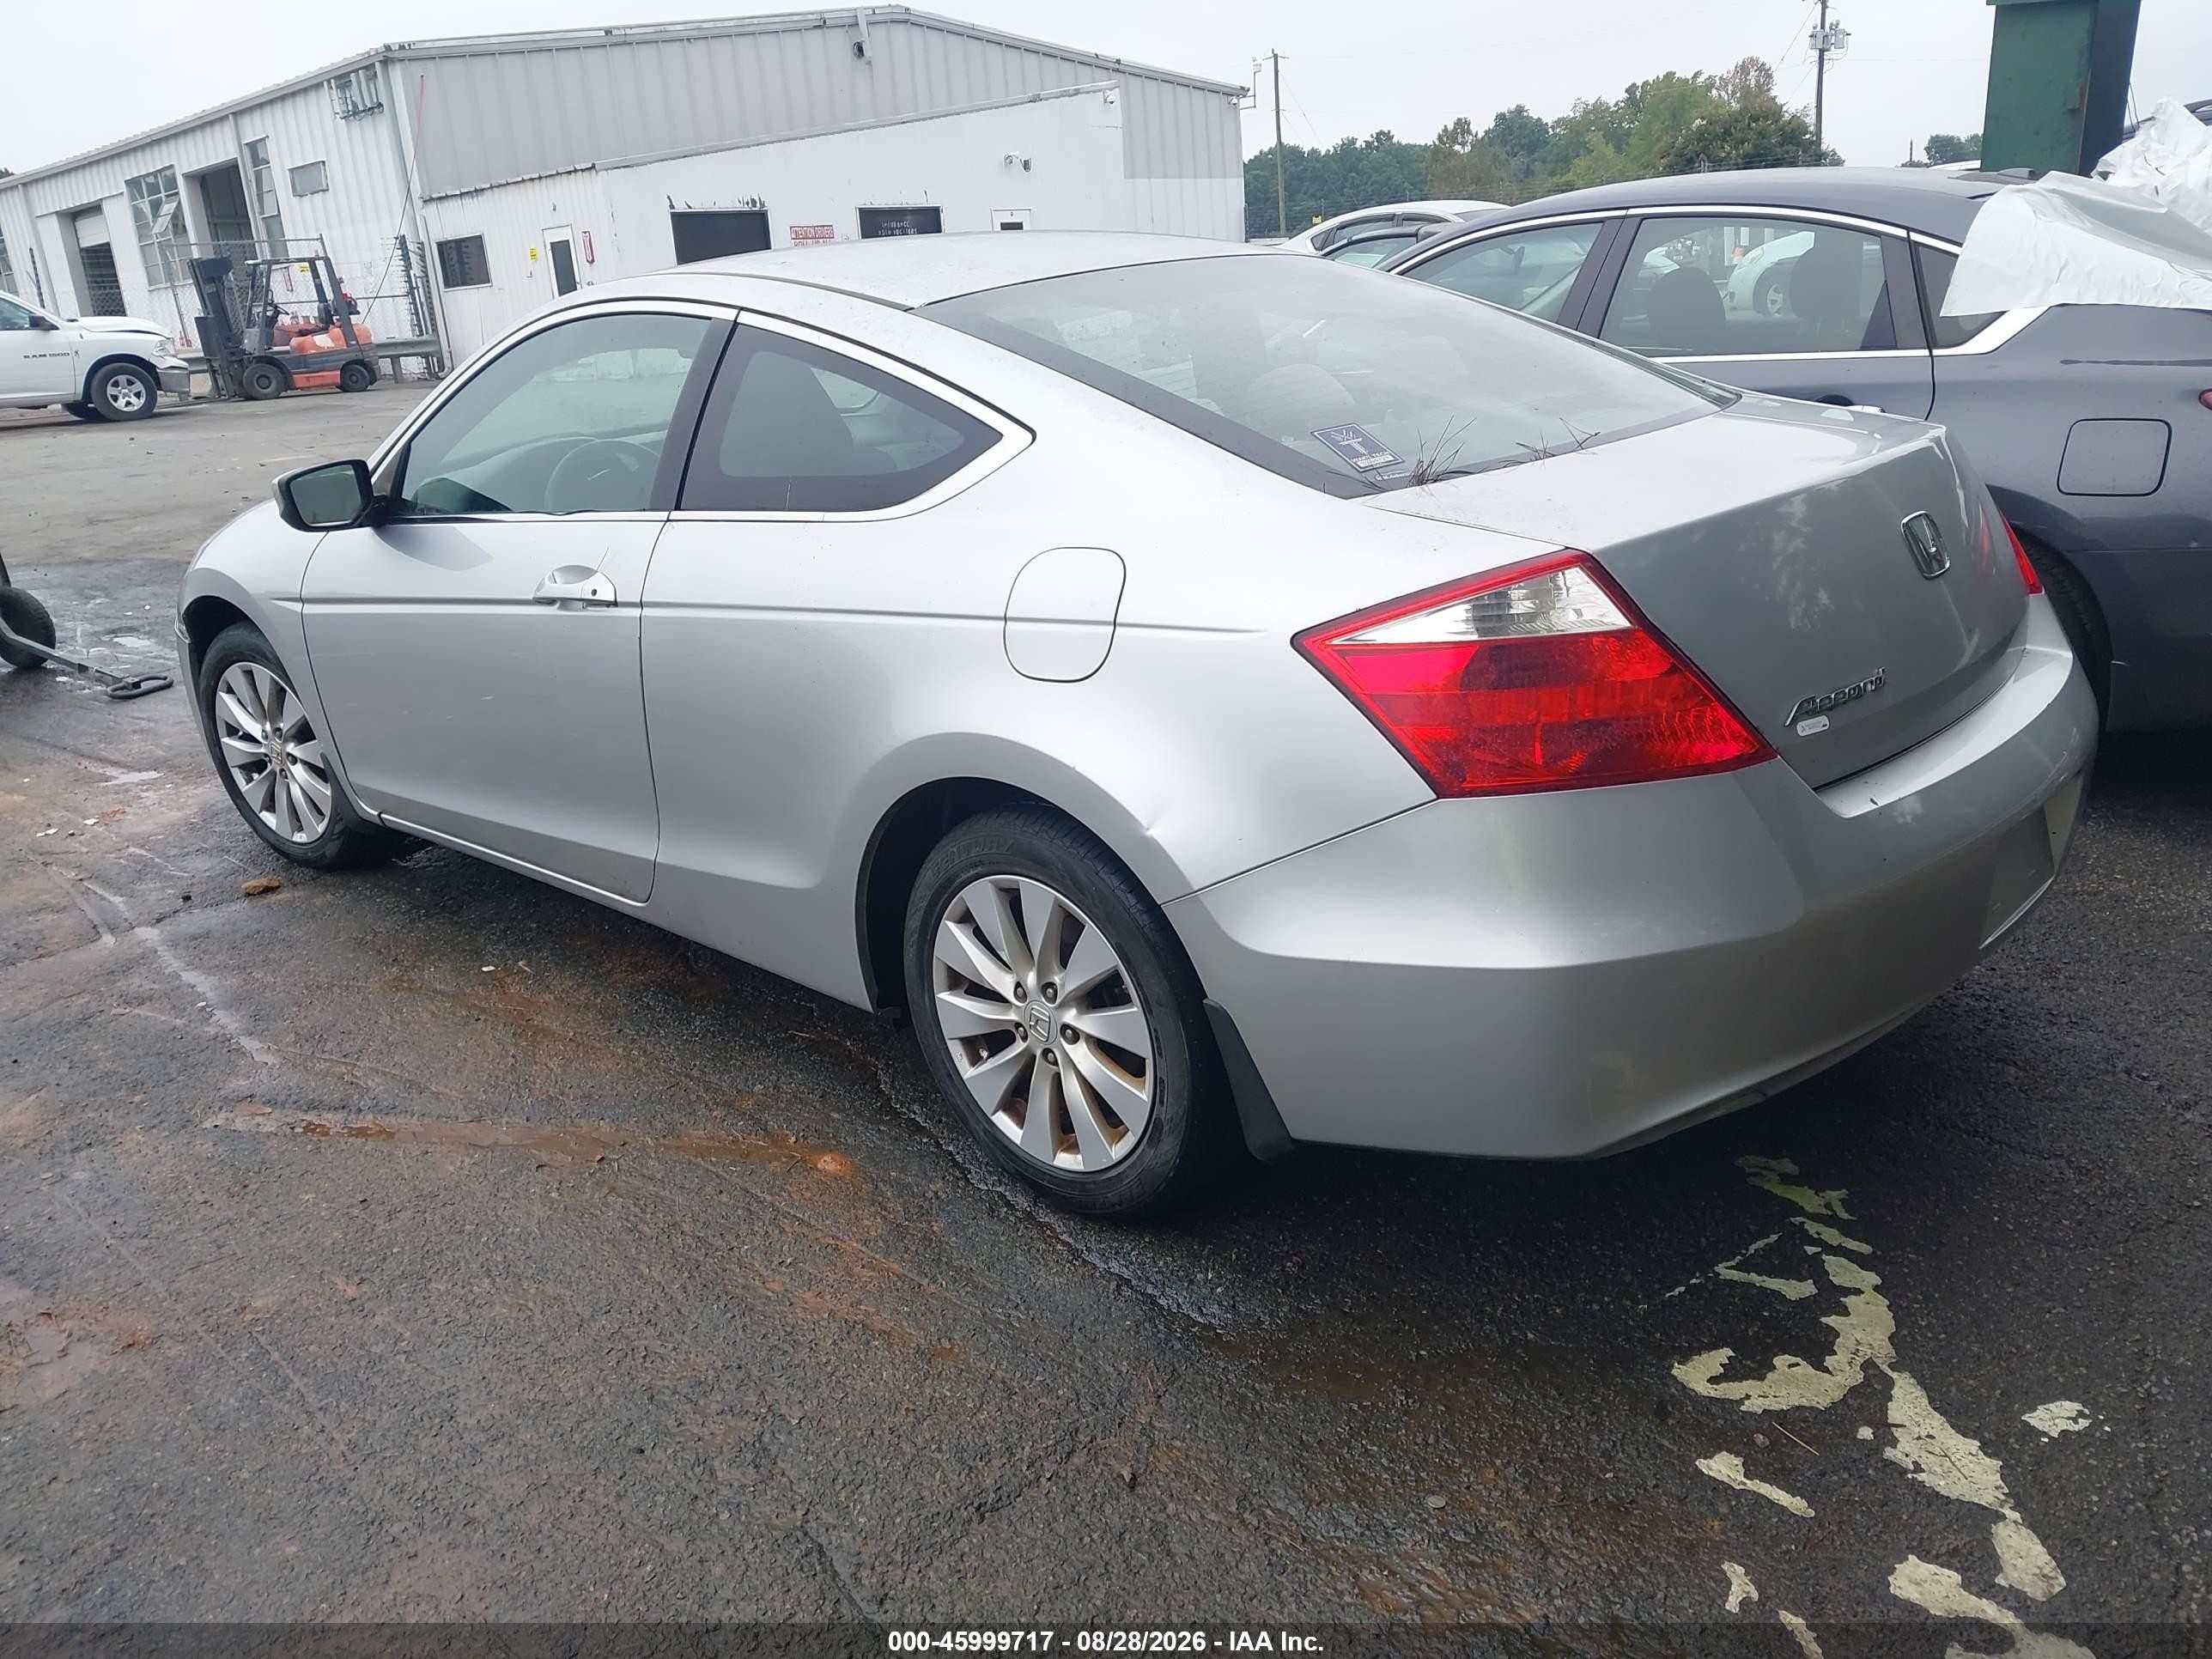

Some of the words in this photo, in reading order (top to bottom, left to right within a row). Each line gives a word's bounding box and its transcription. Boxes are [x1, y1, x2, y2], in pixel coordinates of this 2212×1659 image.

[791, 227, 815, 239] ATTENTION
[815, 226, 834, 238] DRIVERS
[1784, 666, 1887, 727] Accord
